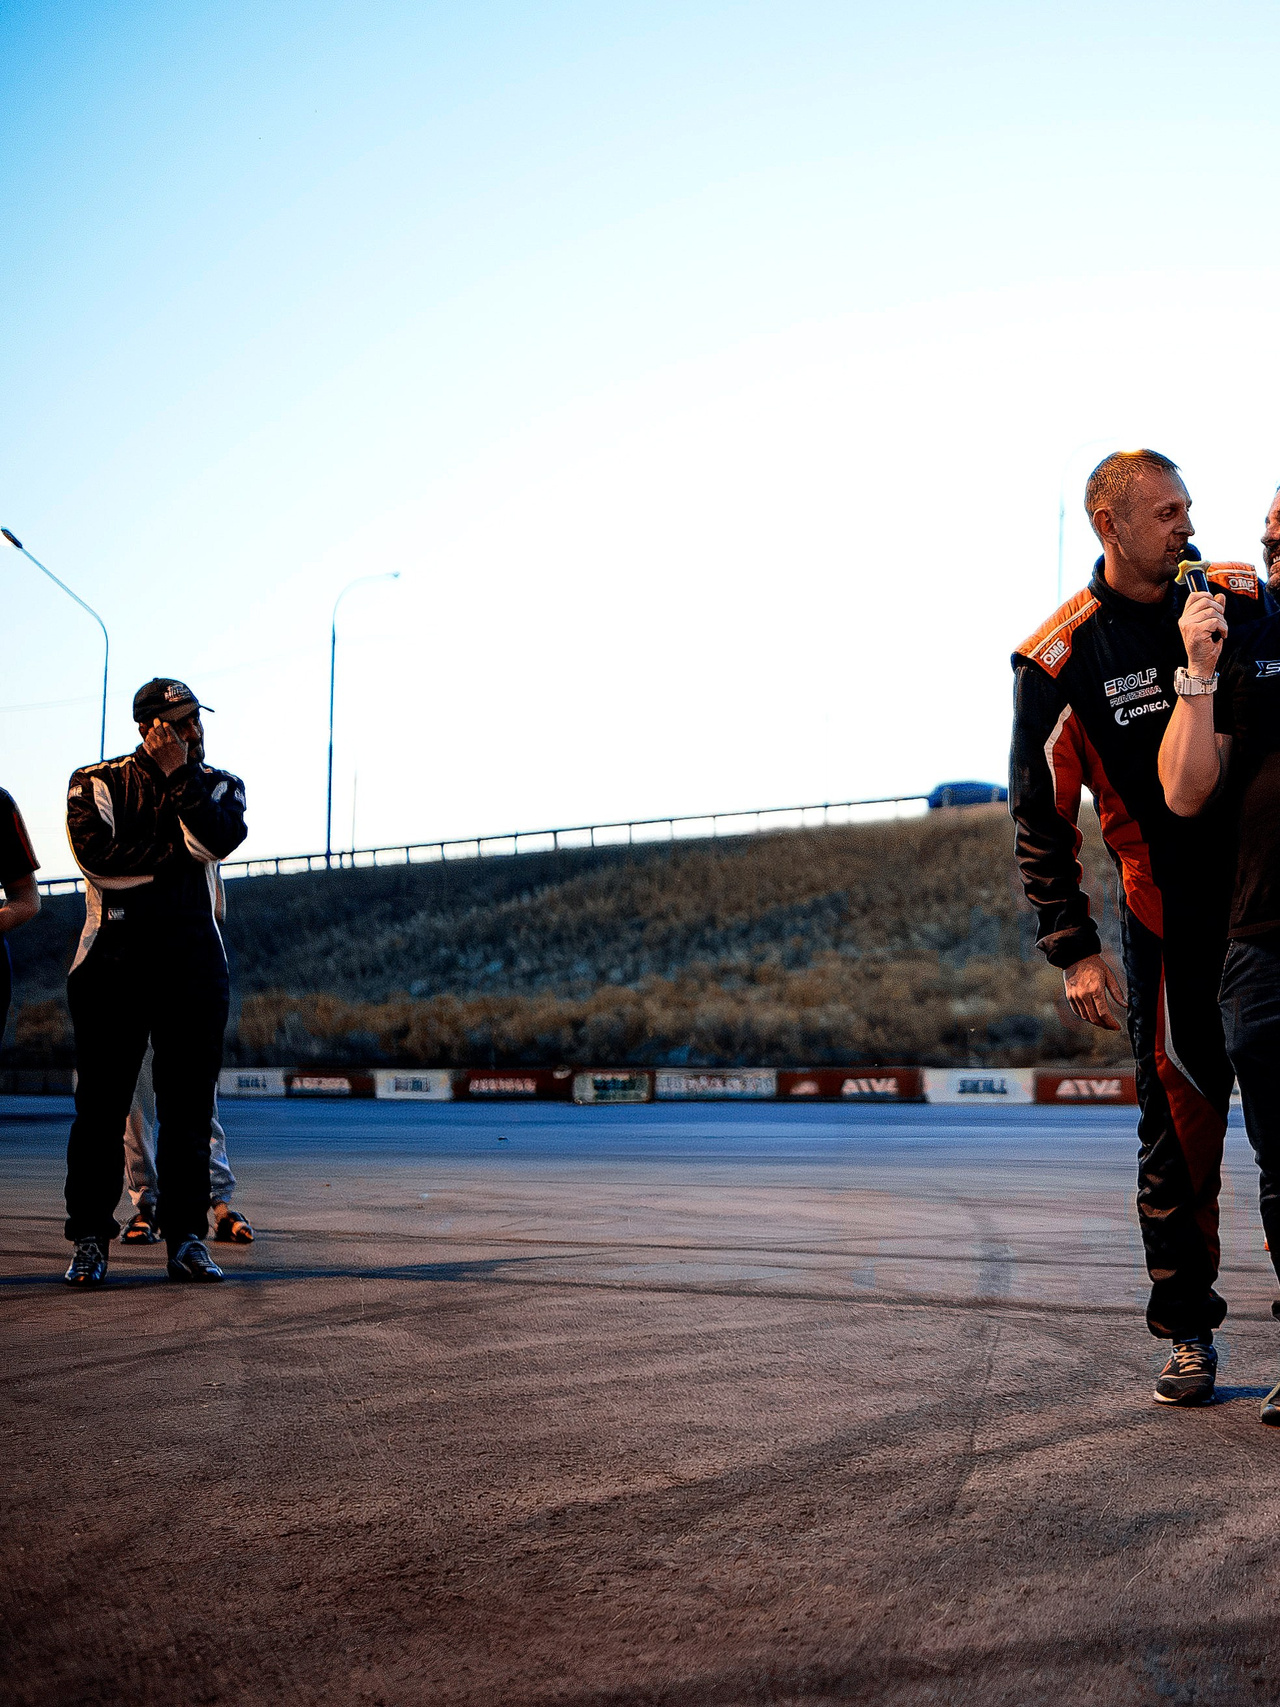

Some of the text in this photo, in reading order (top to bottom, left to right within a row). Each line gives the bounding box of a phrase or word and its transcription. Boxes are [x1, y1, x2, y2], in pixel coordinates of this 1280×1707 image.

[1229, 577, 1255, 589] OMP
[1043, 640, 1066, 666] OMP
[1113, 668, 1158, 695] ROLF
[1128, 700, 1171, 719] КОЛЕСА
